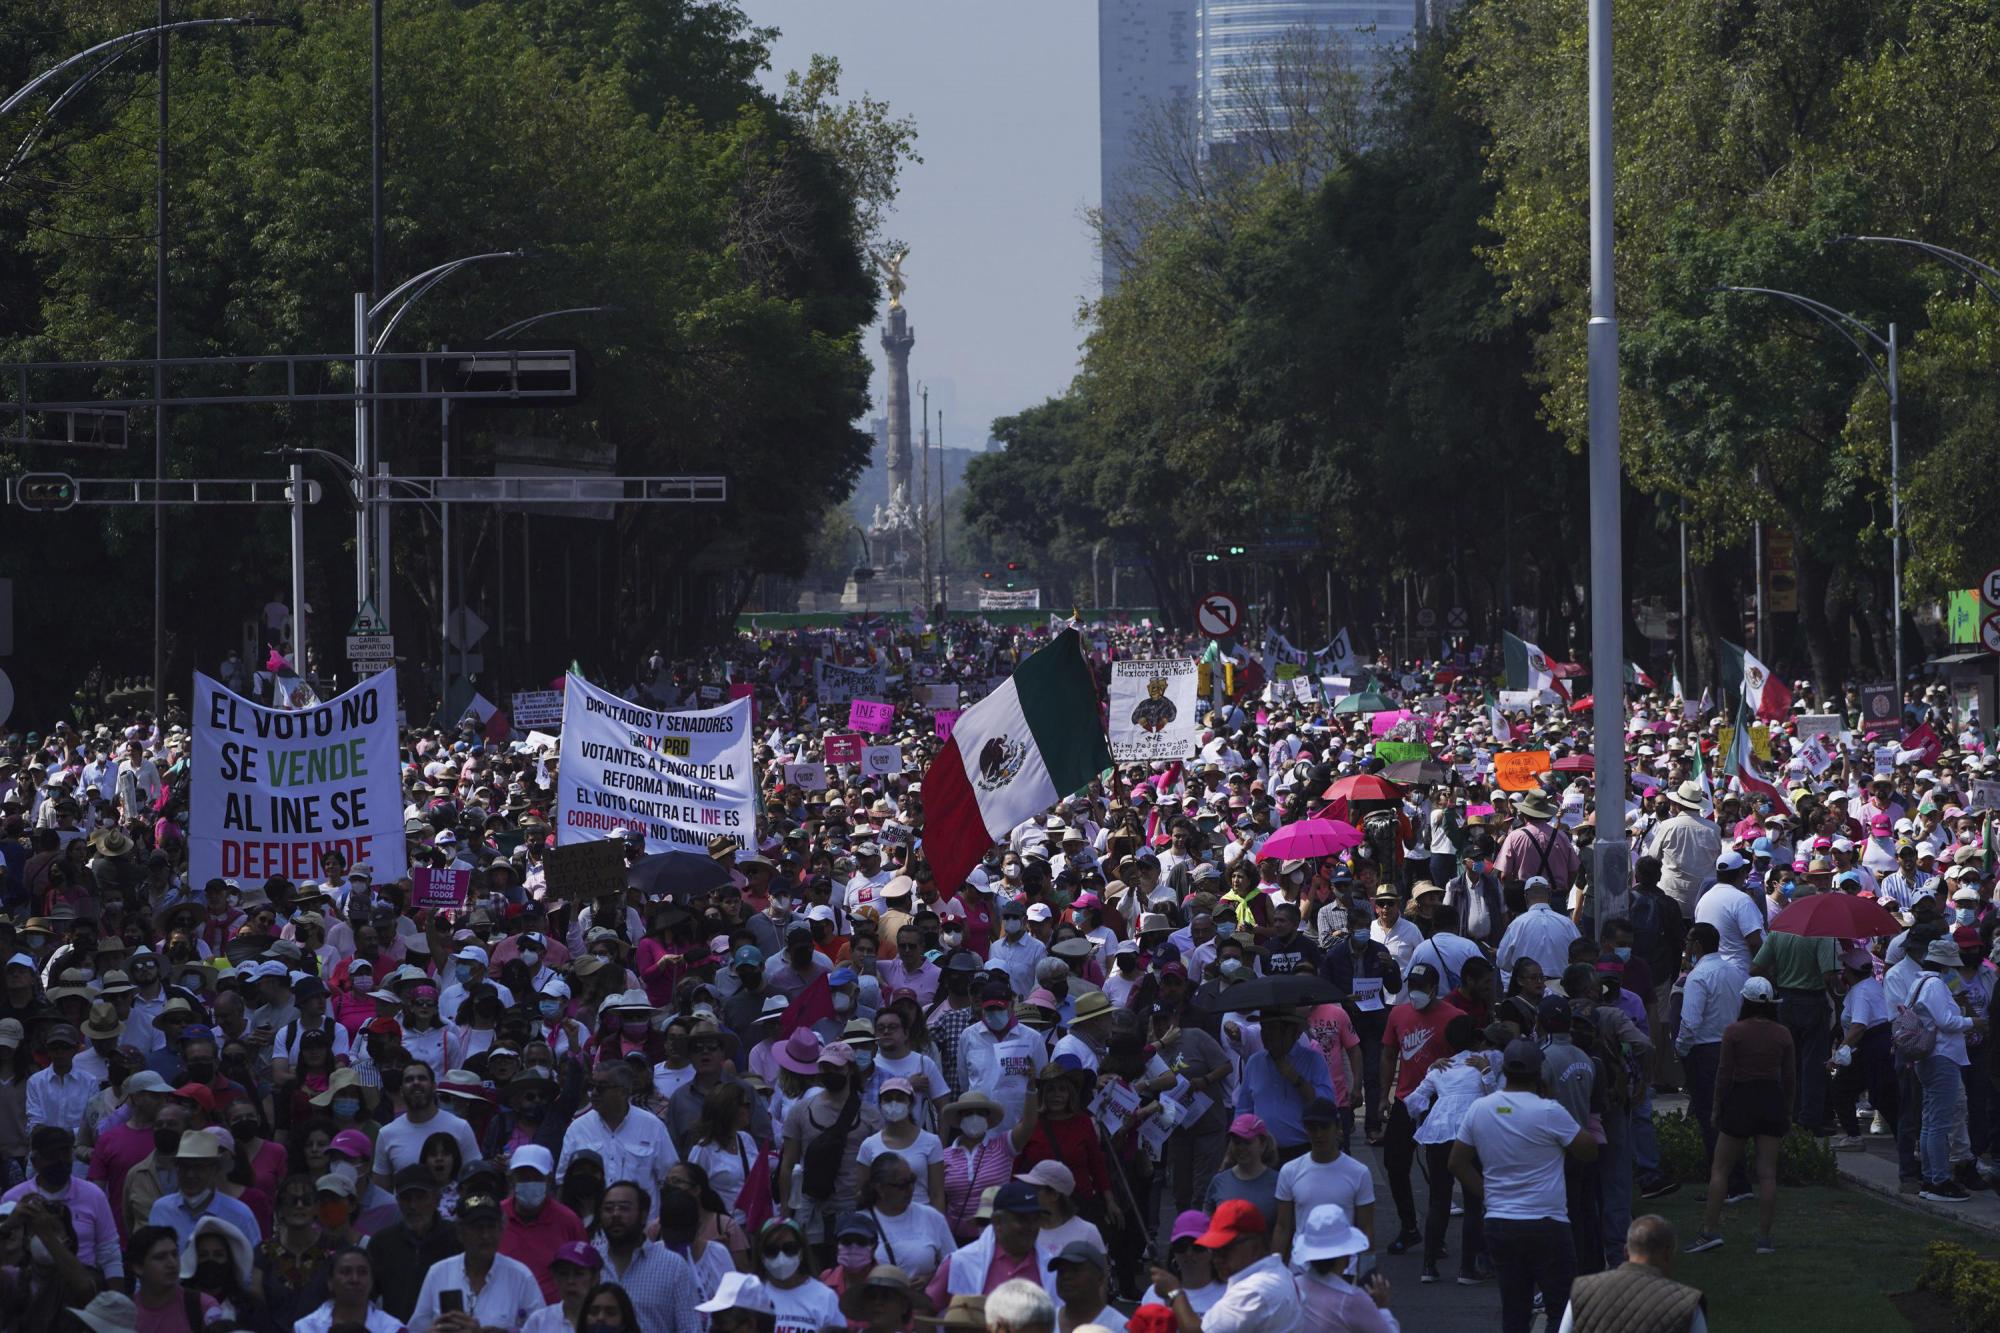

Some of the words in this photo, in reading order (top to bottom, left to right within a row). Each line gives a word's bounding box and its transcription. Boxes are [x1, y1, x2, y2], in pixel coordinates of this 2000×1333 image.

[1117, 662, 1154, 670] Mientras
[1117, 669, 1159, 677] Mexicorea
[1161, 668, 1171, 676] del
[1173, 667, 1193, 676] Norte
[210, 691, 244, 734] EL
[252, 707, 332, 739] VOTO
[341, 688, 378, 731] NO
[586, 696, 652, 729] DIPUTADOS
[656, 714, 664, 729] Y
[666, 716, 733, 733] SENADORES
[856, 704, 877, 717] INE
[653, 736, 661, 752] Y
[664, 737, 690, 756] PRD
[221, 742, 257, 782] SE
[267, 738, 368, 787] VENDE
[582, 741, 646, 768] VOTANTES
[648, 760, 656, 771] A
[659, 760, 698, 779] FAVOR
[701, 764, 715, 780] DE
[719, 764, 734, 780] LA
[602, 769, 663, 795] REFORMA
[666, 781, 716, 801] MILITAR
[223, 792, 262, 832] AL
[270, 796, 322, 833] INE
[330, 788, 369, 830] SE
[577, 787, 592, 805] EL
[594, 791, 626, 811] VOTO
[629, 799, 679, 822] CONTRA
[683, 806, 698, 824] EL
[701, 808, 721, 825] INE
[725, 810, 740, 827] ES
[567, 809, 647, 838] CORRUPCIÓN
[650, 823, 667, 840] NO
[429, 883, 455, 891] SOMOS
[430, 869, 457, 884] INE
[428, 890, 454, 898] TODOS
[1403, 1028, 1430, 1050] NIKE
